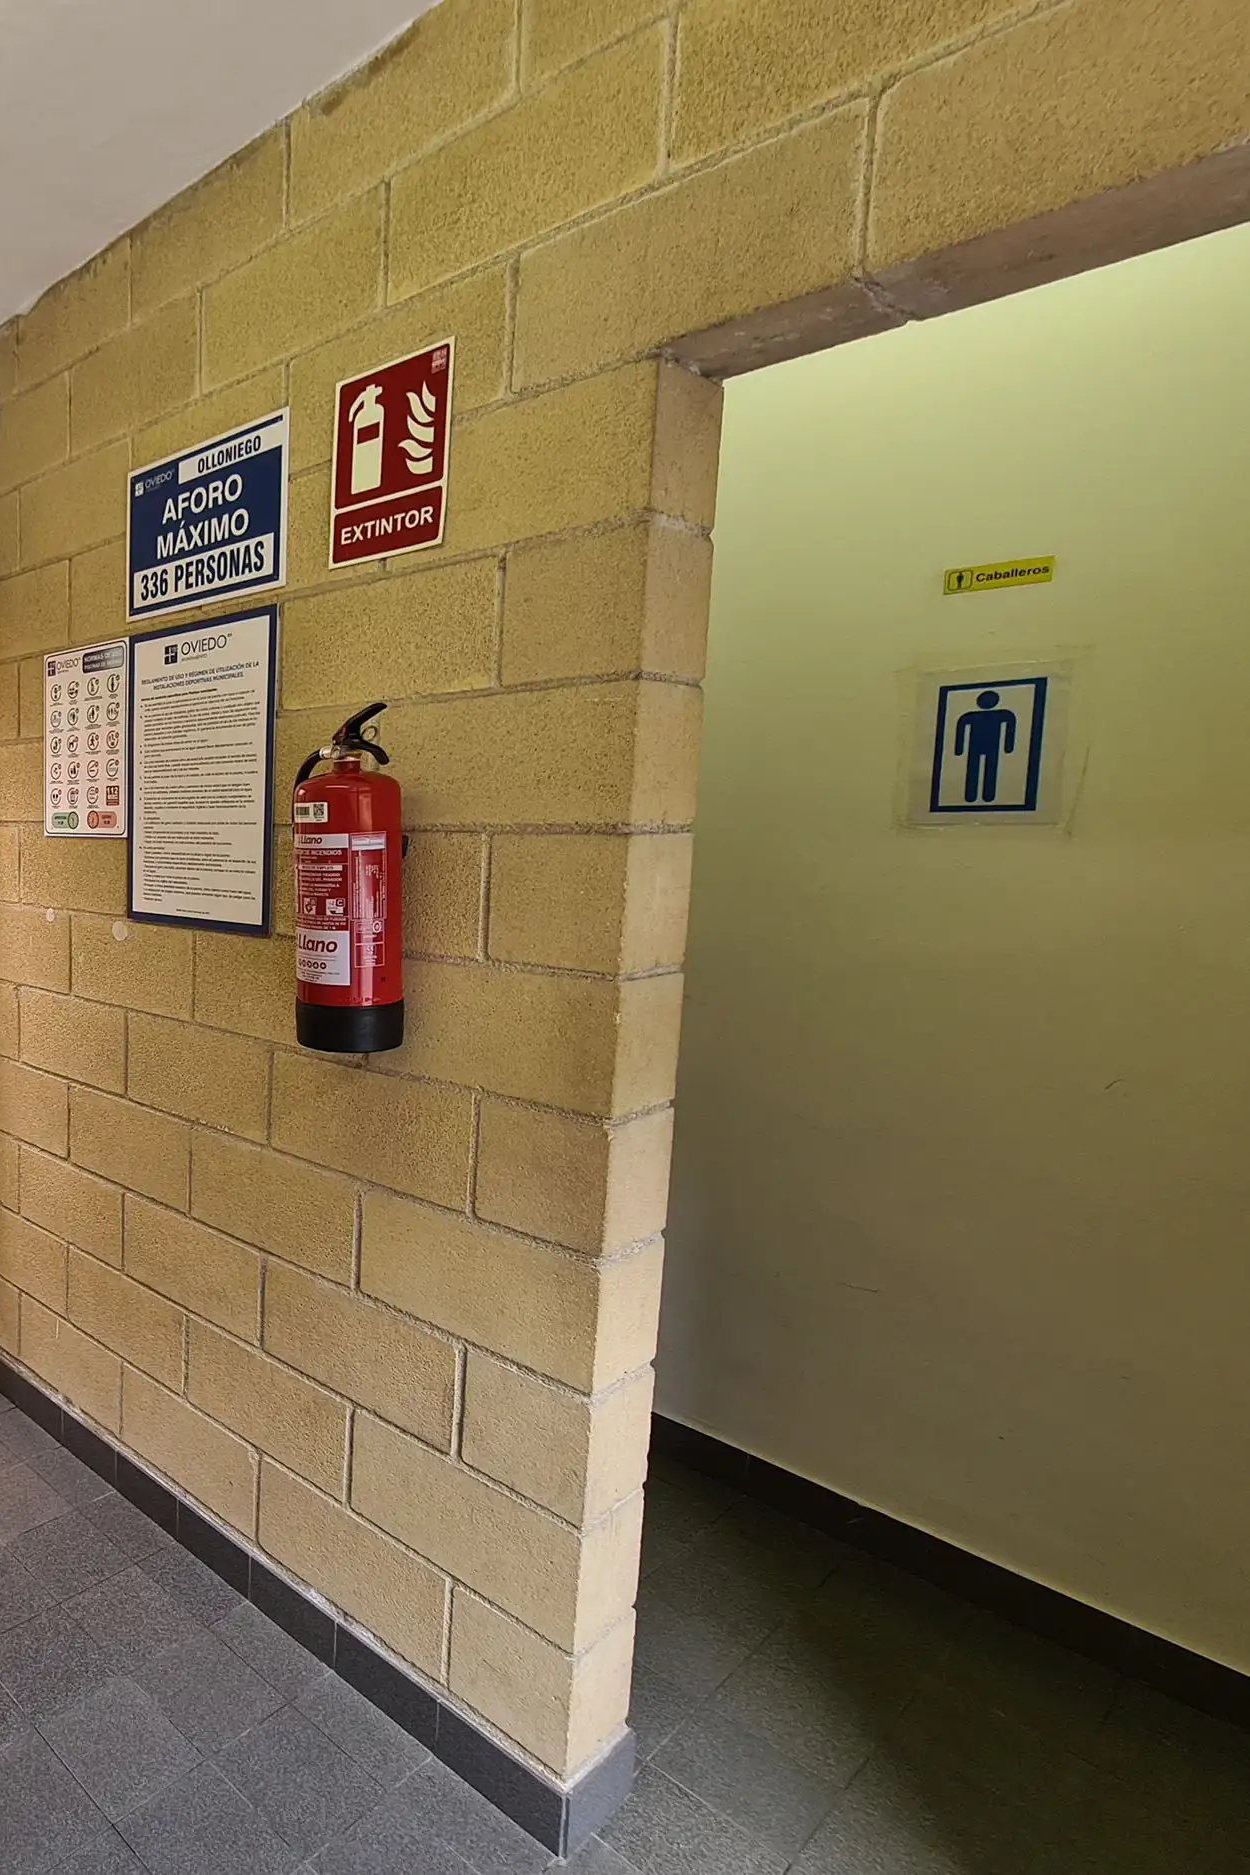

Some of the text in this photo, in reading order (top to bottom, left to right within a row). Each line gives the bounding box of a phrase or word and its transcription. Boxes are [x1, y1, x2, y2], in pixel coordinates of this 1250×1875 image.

[197, 435, 262, 473] OLLONIEGO
[145, 471, 173, 489] OVIEDO
[162, 473, 243, 525] AFORO
[156, 508, 249, 560] MÁXIMO
[340, 505, 434, 546] EXTINTOR
[140, 540, 265, 602] 336 PERSONAS
[976, 566, 1050, 583] Caballeros
[181, 634, 228, 656] OVIEDO
[57, 658, 79, 671] OVIEDO
